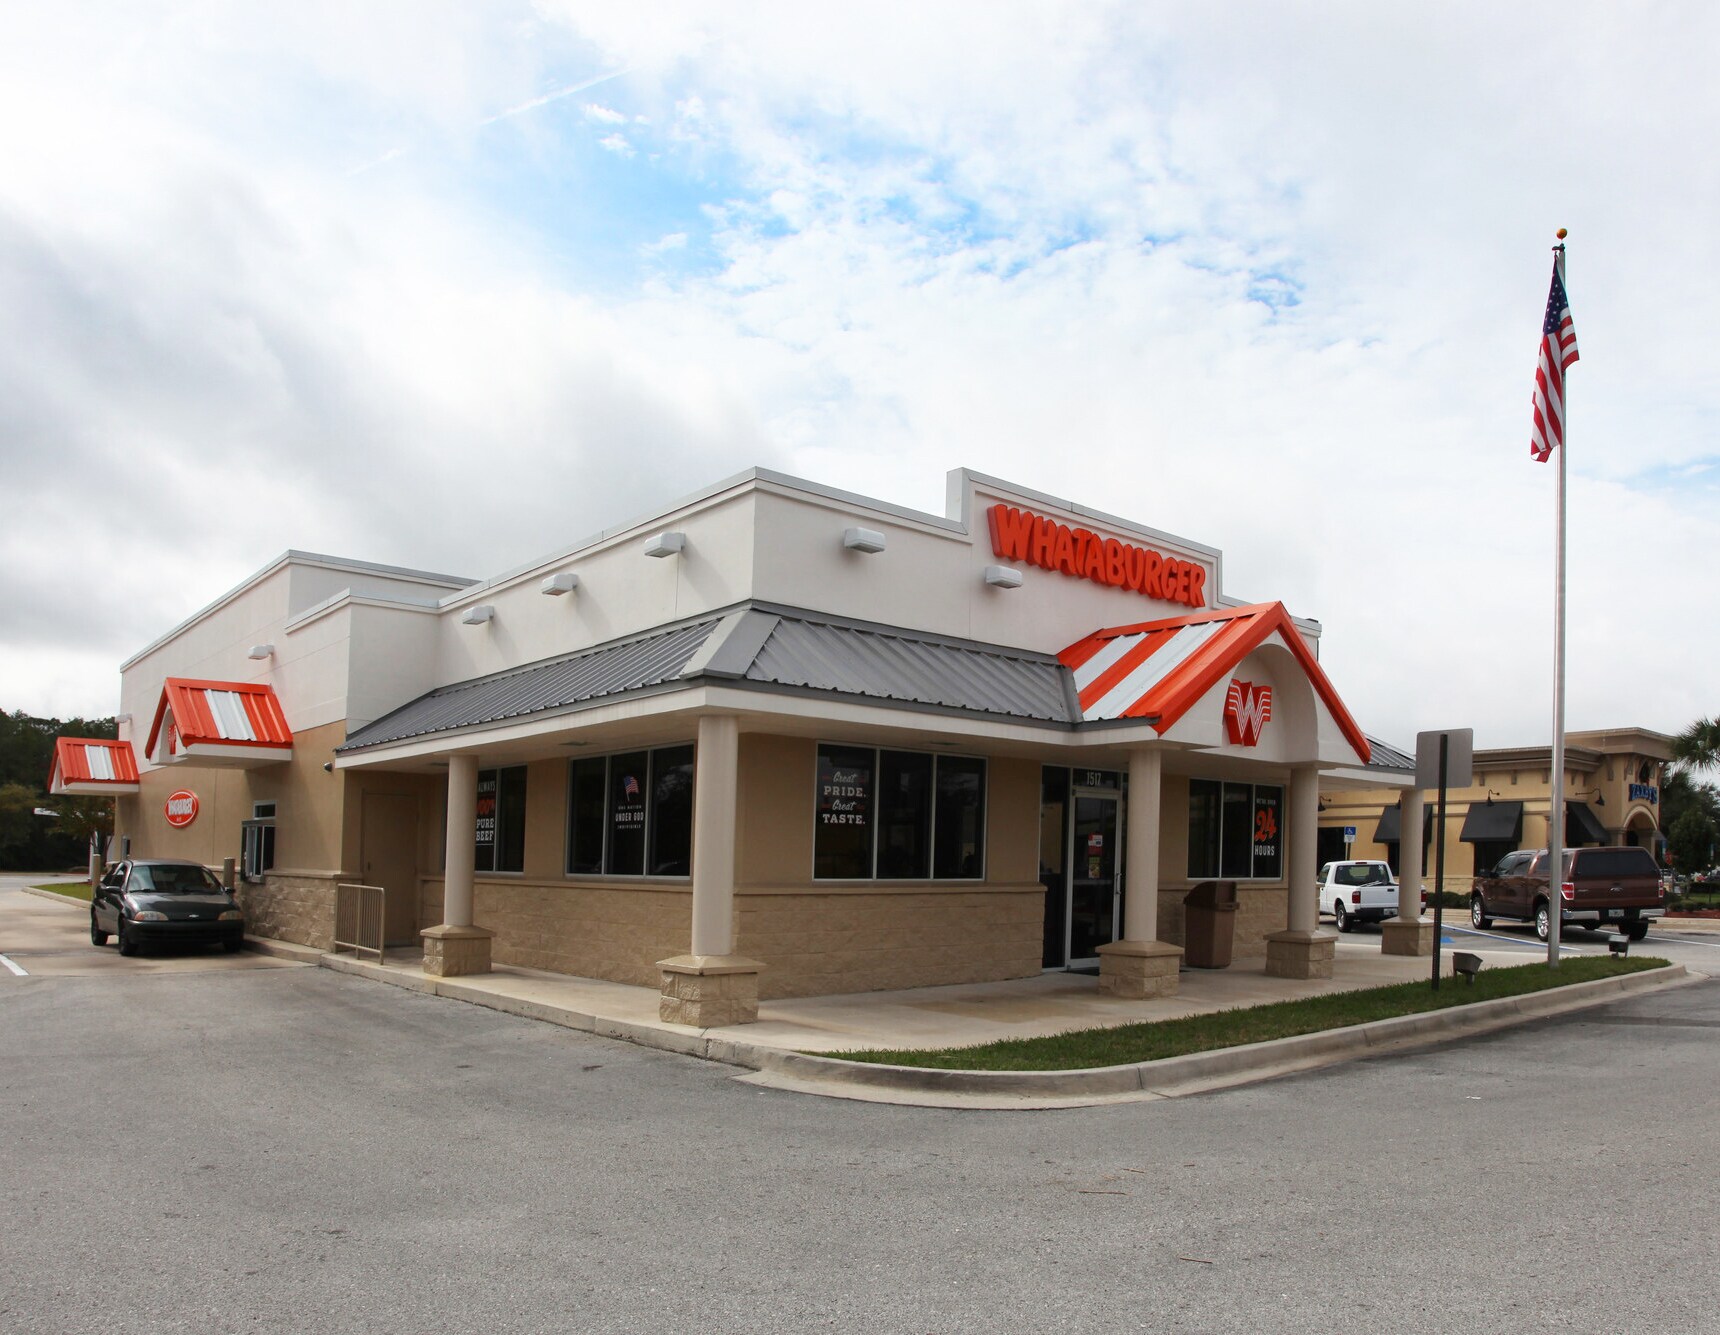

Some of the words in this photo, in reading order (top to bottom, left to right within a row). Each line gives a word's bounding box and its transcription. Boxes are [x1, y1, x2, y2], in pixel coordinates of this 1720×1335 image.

[987, 504, 1206, 608] WHATABURGER
[1224, 679, 1272, 747] W
[833, 771, 858, 783] Great
[1086, 771, 1102, 786] 1517
[823, 785, 867, 797] PRIDE.
[832, 799, 857, 811] Great
[615, 812, 632, 822] UNDER
[633, 811, 644, 821] GOD
[822, 813, 866, 825] TASTE.
[476, 818, 495, 828] PURE
[1254, 808, 1277, 841] 24
[476, 831, 494, 841] BEEF
[1254, 845, 1275, 856] HOURS
